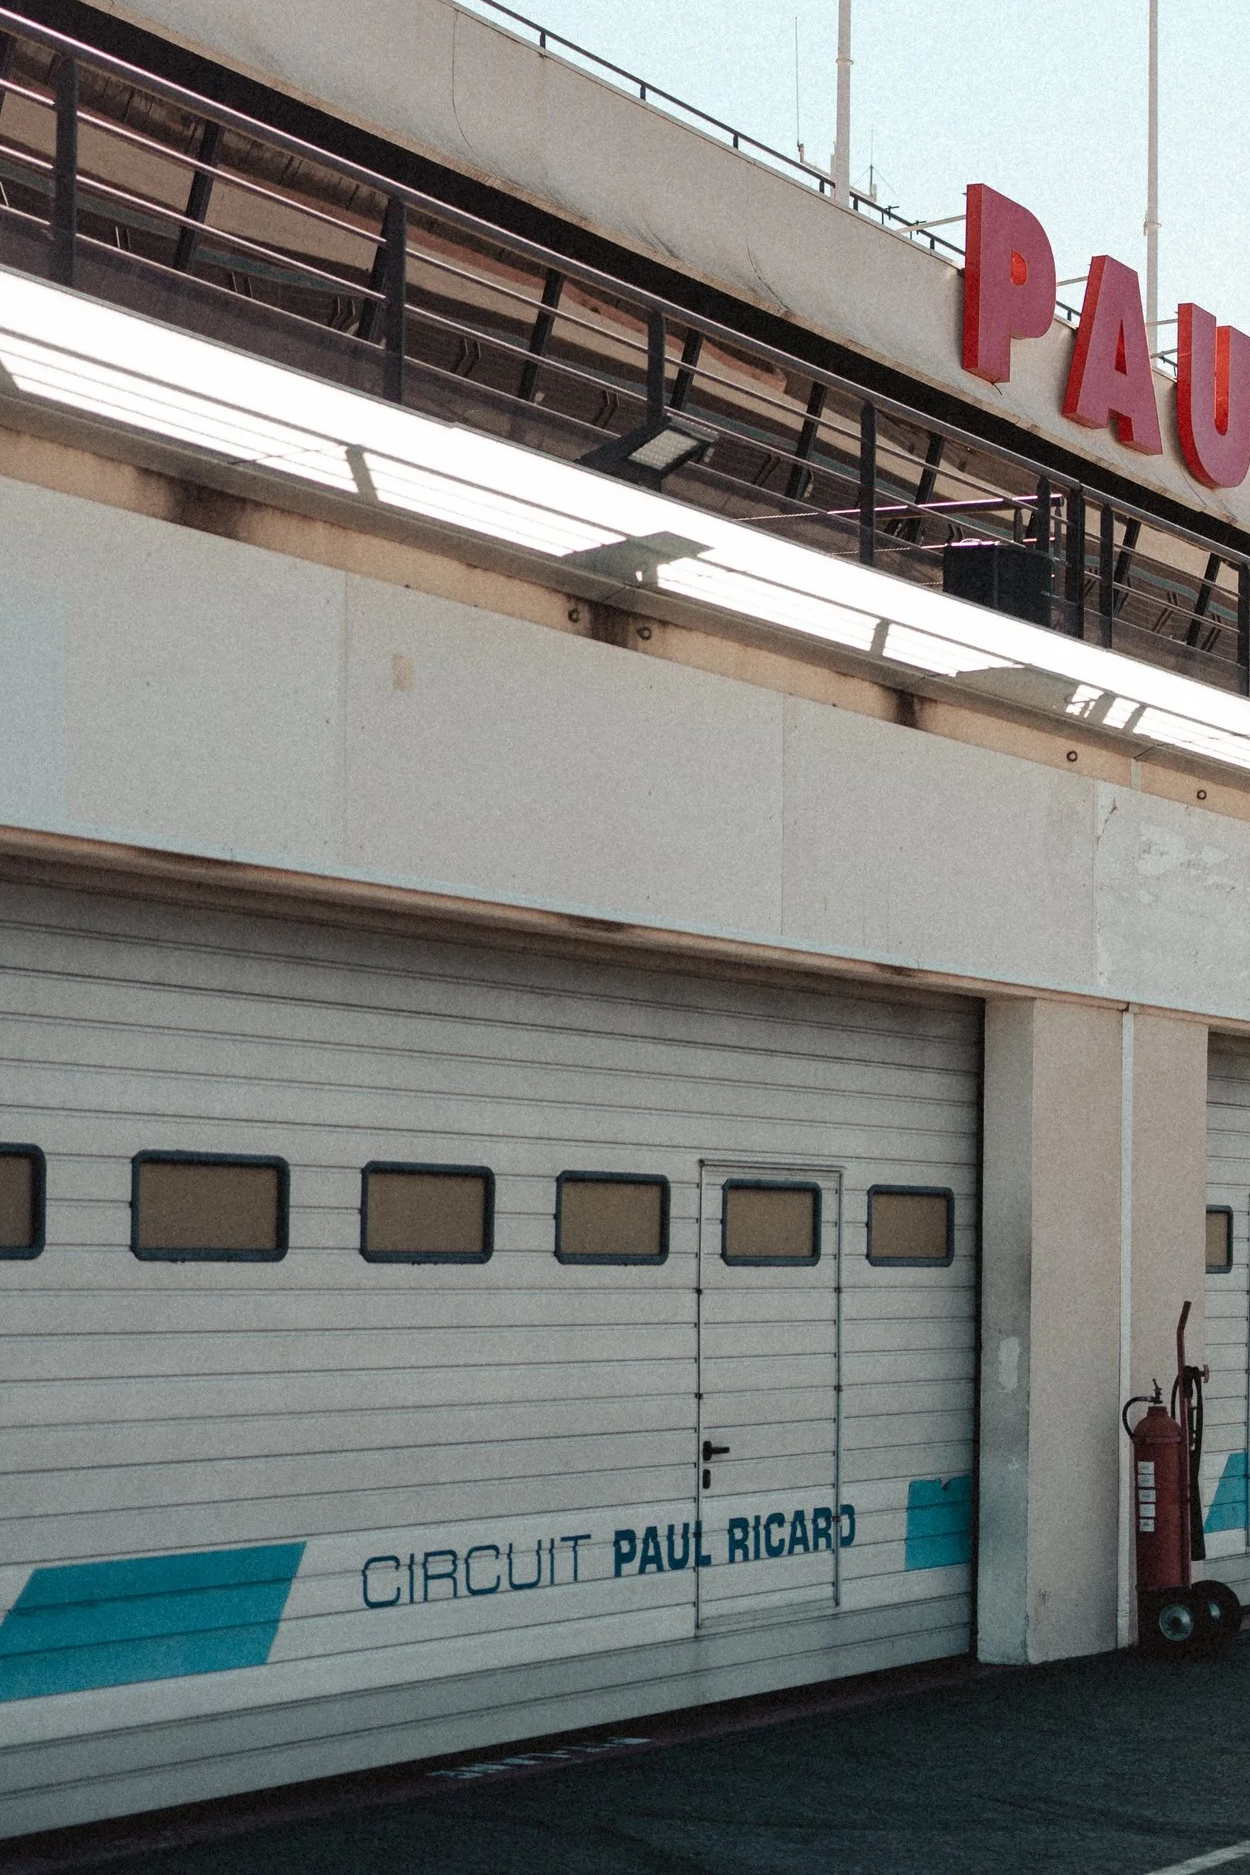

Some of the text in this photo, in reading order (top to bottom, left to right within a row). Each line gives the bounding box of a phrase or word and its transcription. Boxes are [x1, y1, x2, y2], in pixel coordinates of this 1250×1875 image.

[362, 1504, 856, 1609] CIRCUIT PAUL RICARD
